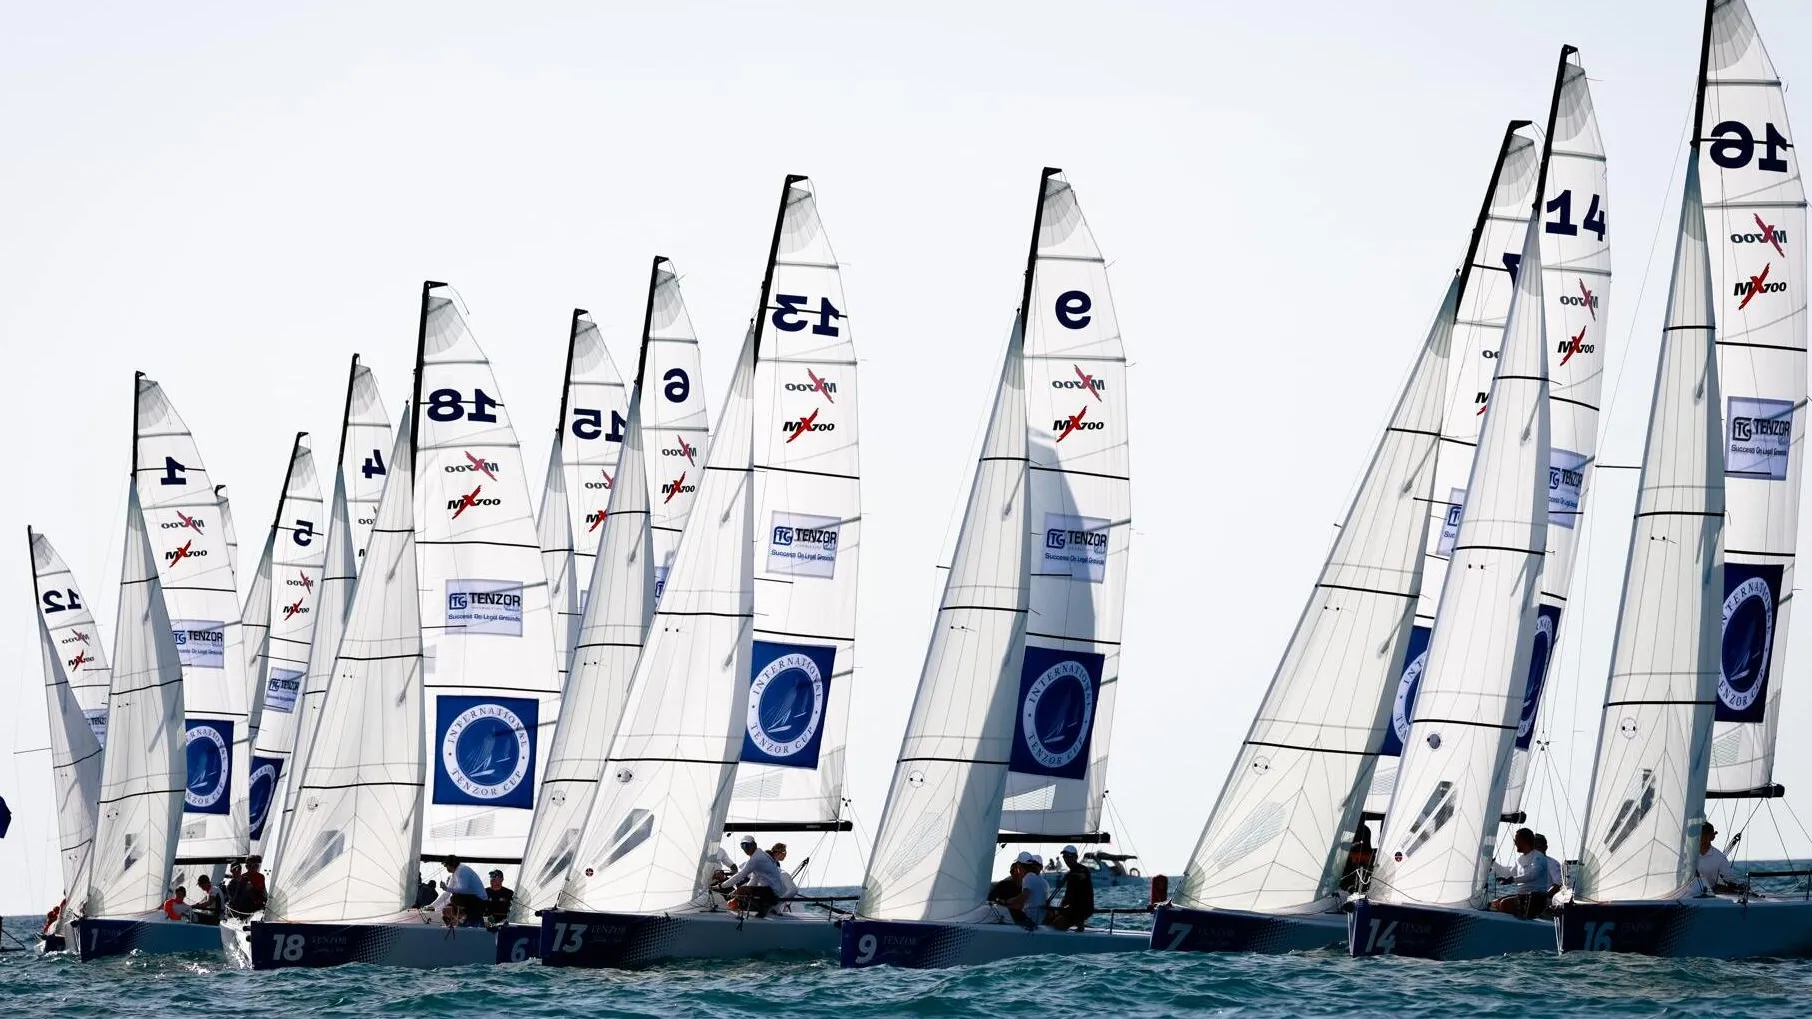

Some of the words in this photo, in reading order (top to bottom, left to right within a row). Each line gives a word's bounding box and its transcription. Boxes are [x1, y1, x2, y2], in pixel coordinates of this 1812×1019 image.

[1546, 190, 1606, 242] 14
[1734, 262, 1786, 310] MX700
[783, 408, 834, 443] MX700
[1053, 405, 1104, 442] MX700
[1753, 418, 1790, 436] TENZOR
[447, 484, 501, 520] MX700
[795, 528, 837, 544] TENZOR
[1068, 531, 1107, 547] TENZOR
[469, 593, 520, 606] TENZOR
[1722, 582, 1772, 634] NTERNATIONAL
[187, 631, 223, 642] TENZOR
[753, 657, 821, 700] INTERNATIONAL
[1718, 680, 1748, 706] ENZOR
[448, 707, 527, 747] INTERNATIONAL
[750, 723, 789, 754] TENZOR
[796, 726, 813, 748] CUP
[1028, 732, 1062, 765] TENZOR
[451, 768, 497, 796] TENZOR
[504, 771, 521, 791] CUP
[90, 928, 98, 951] 1
[272, 934, 305, 961] 18
[510, 938, 529, 962] 6
[552, 923, 588, 952] 13
[856, 934, 878, 964] 9
[1167, 924, 1193, 951] 7
[1365, 918, 1399, 954] 14
[1584, 922, 1616, 951] 16
